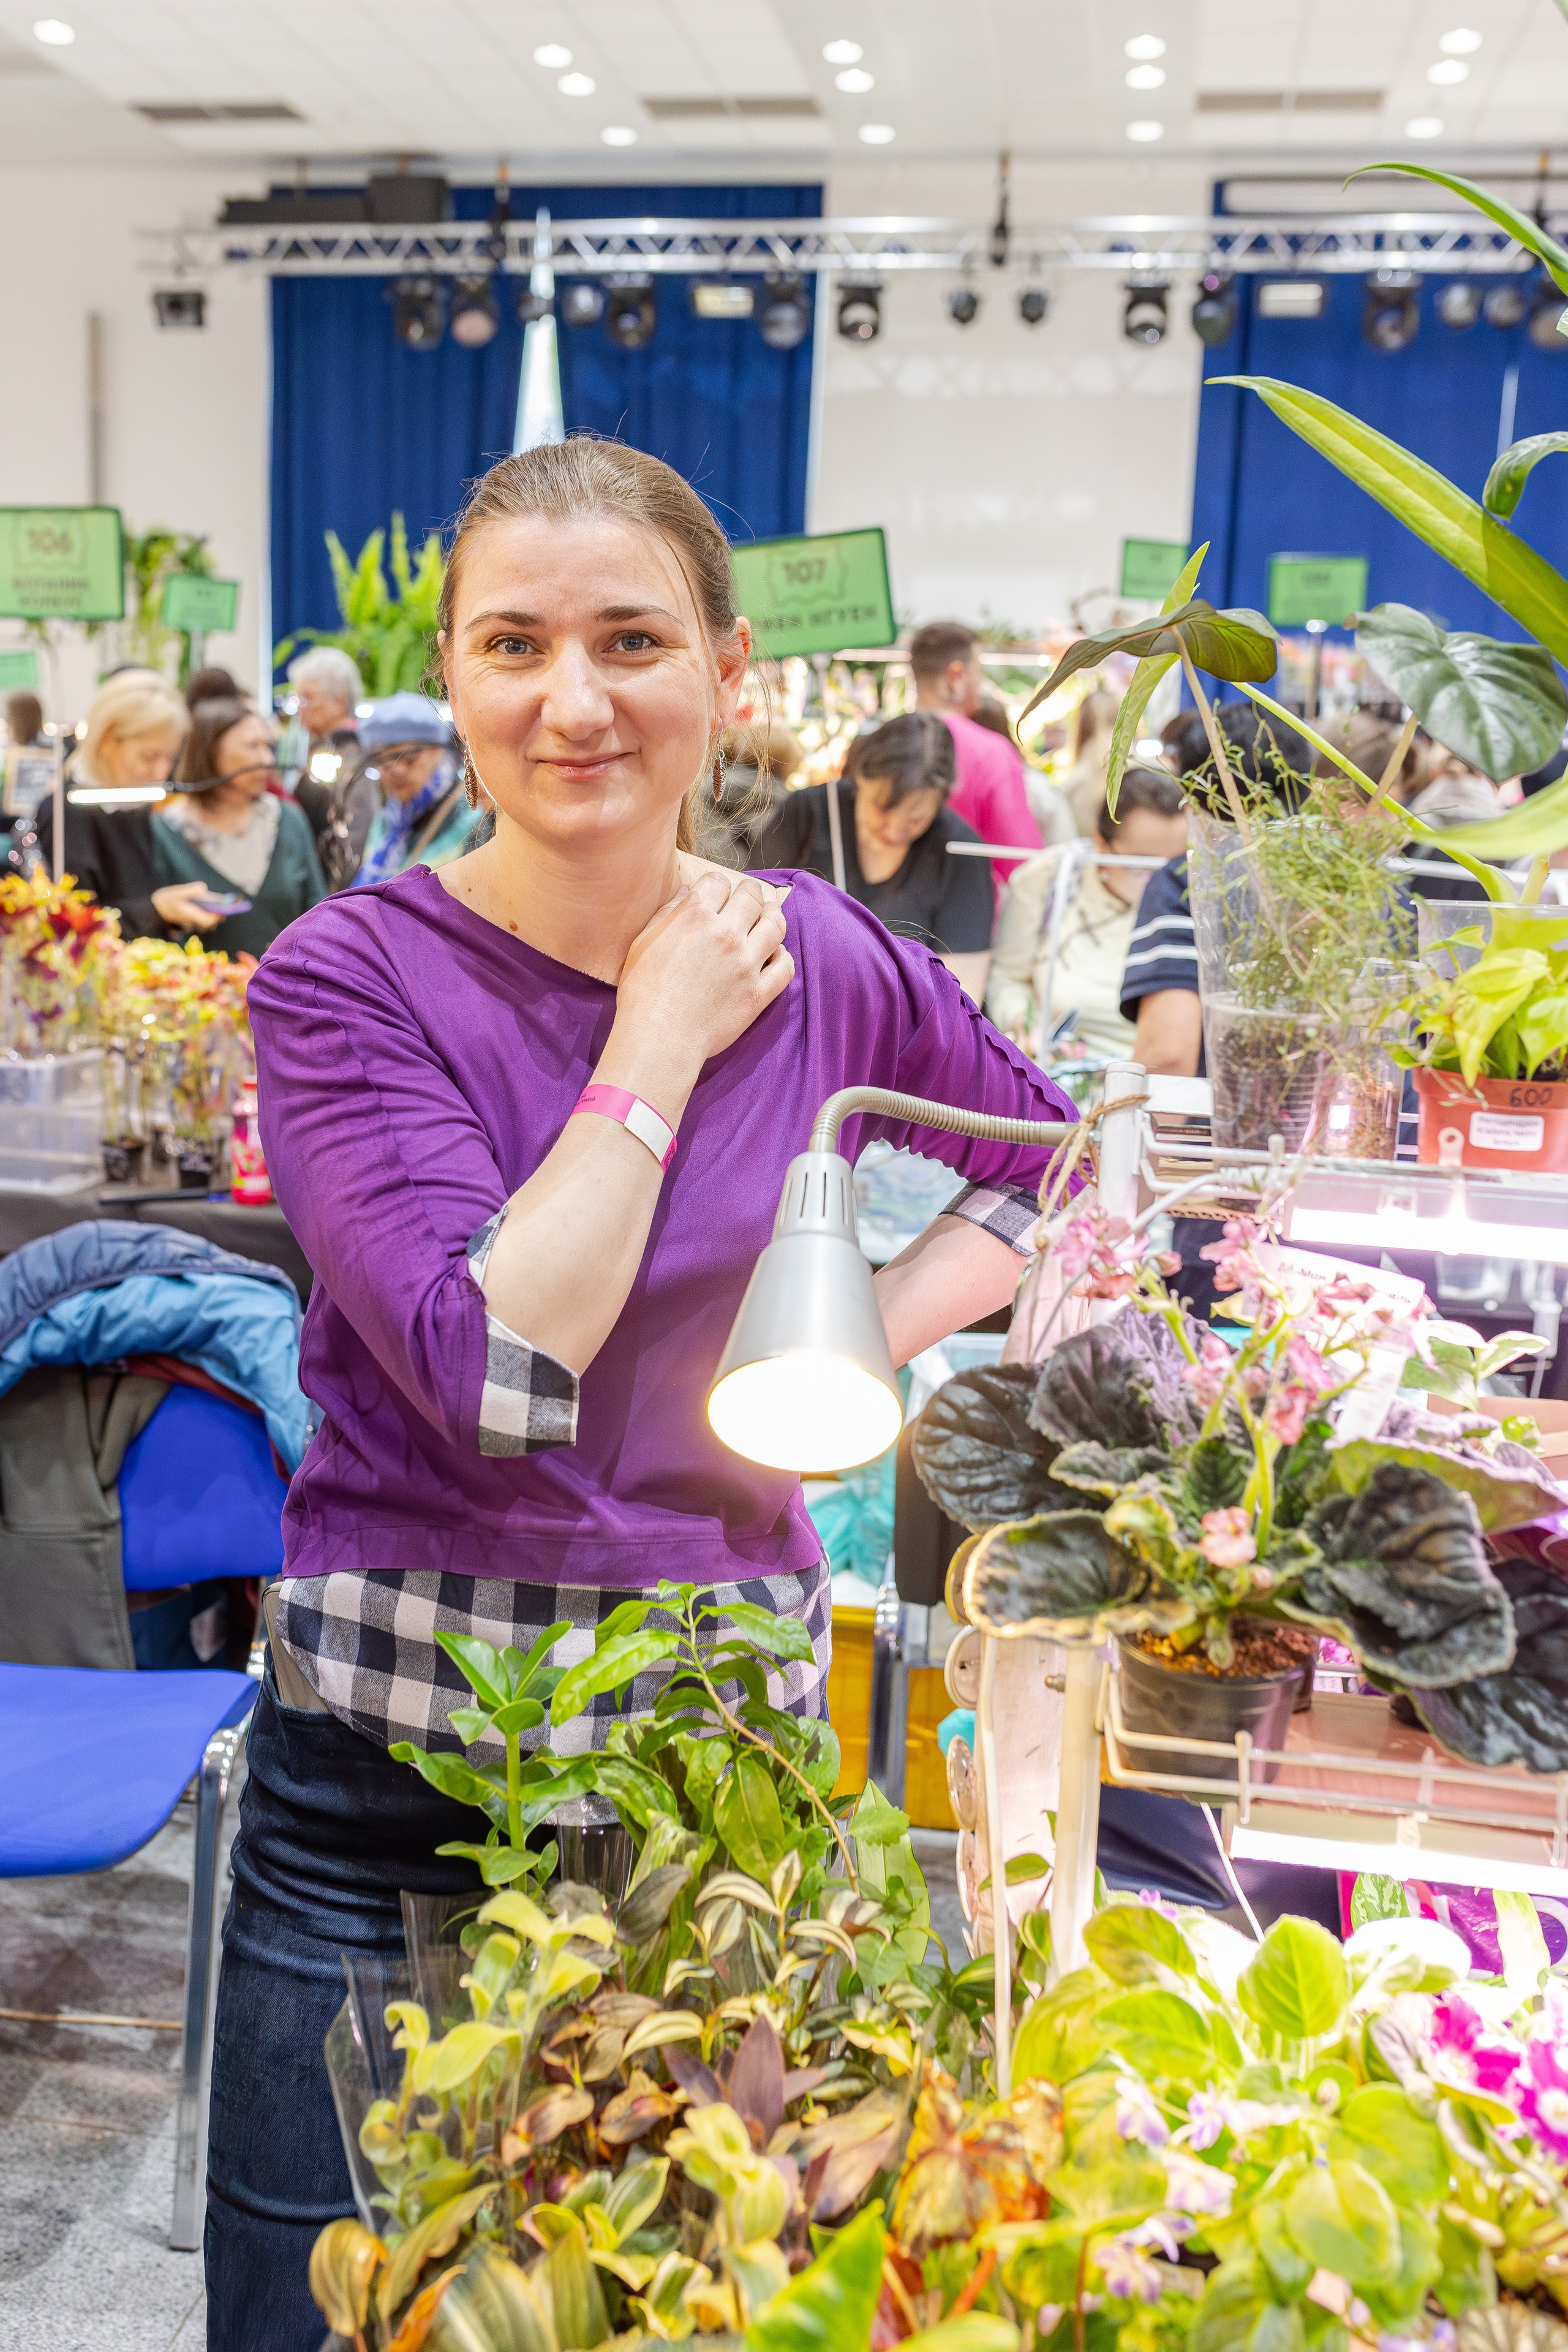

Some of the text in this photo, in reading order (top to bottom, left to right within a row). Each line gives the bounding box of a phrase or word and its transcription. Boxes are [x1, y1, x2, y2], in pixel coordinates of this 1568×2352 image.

[28, 527, 74, 555] 106
[783, 558, 826, 585] 107
[1509, 1087, 1553, 1107] 600
